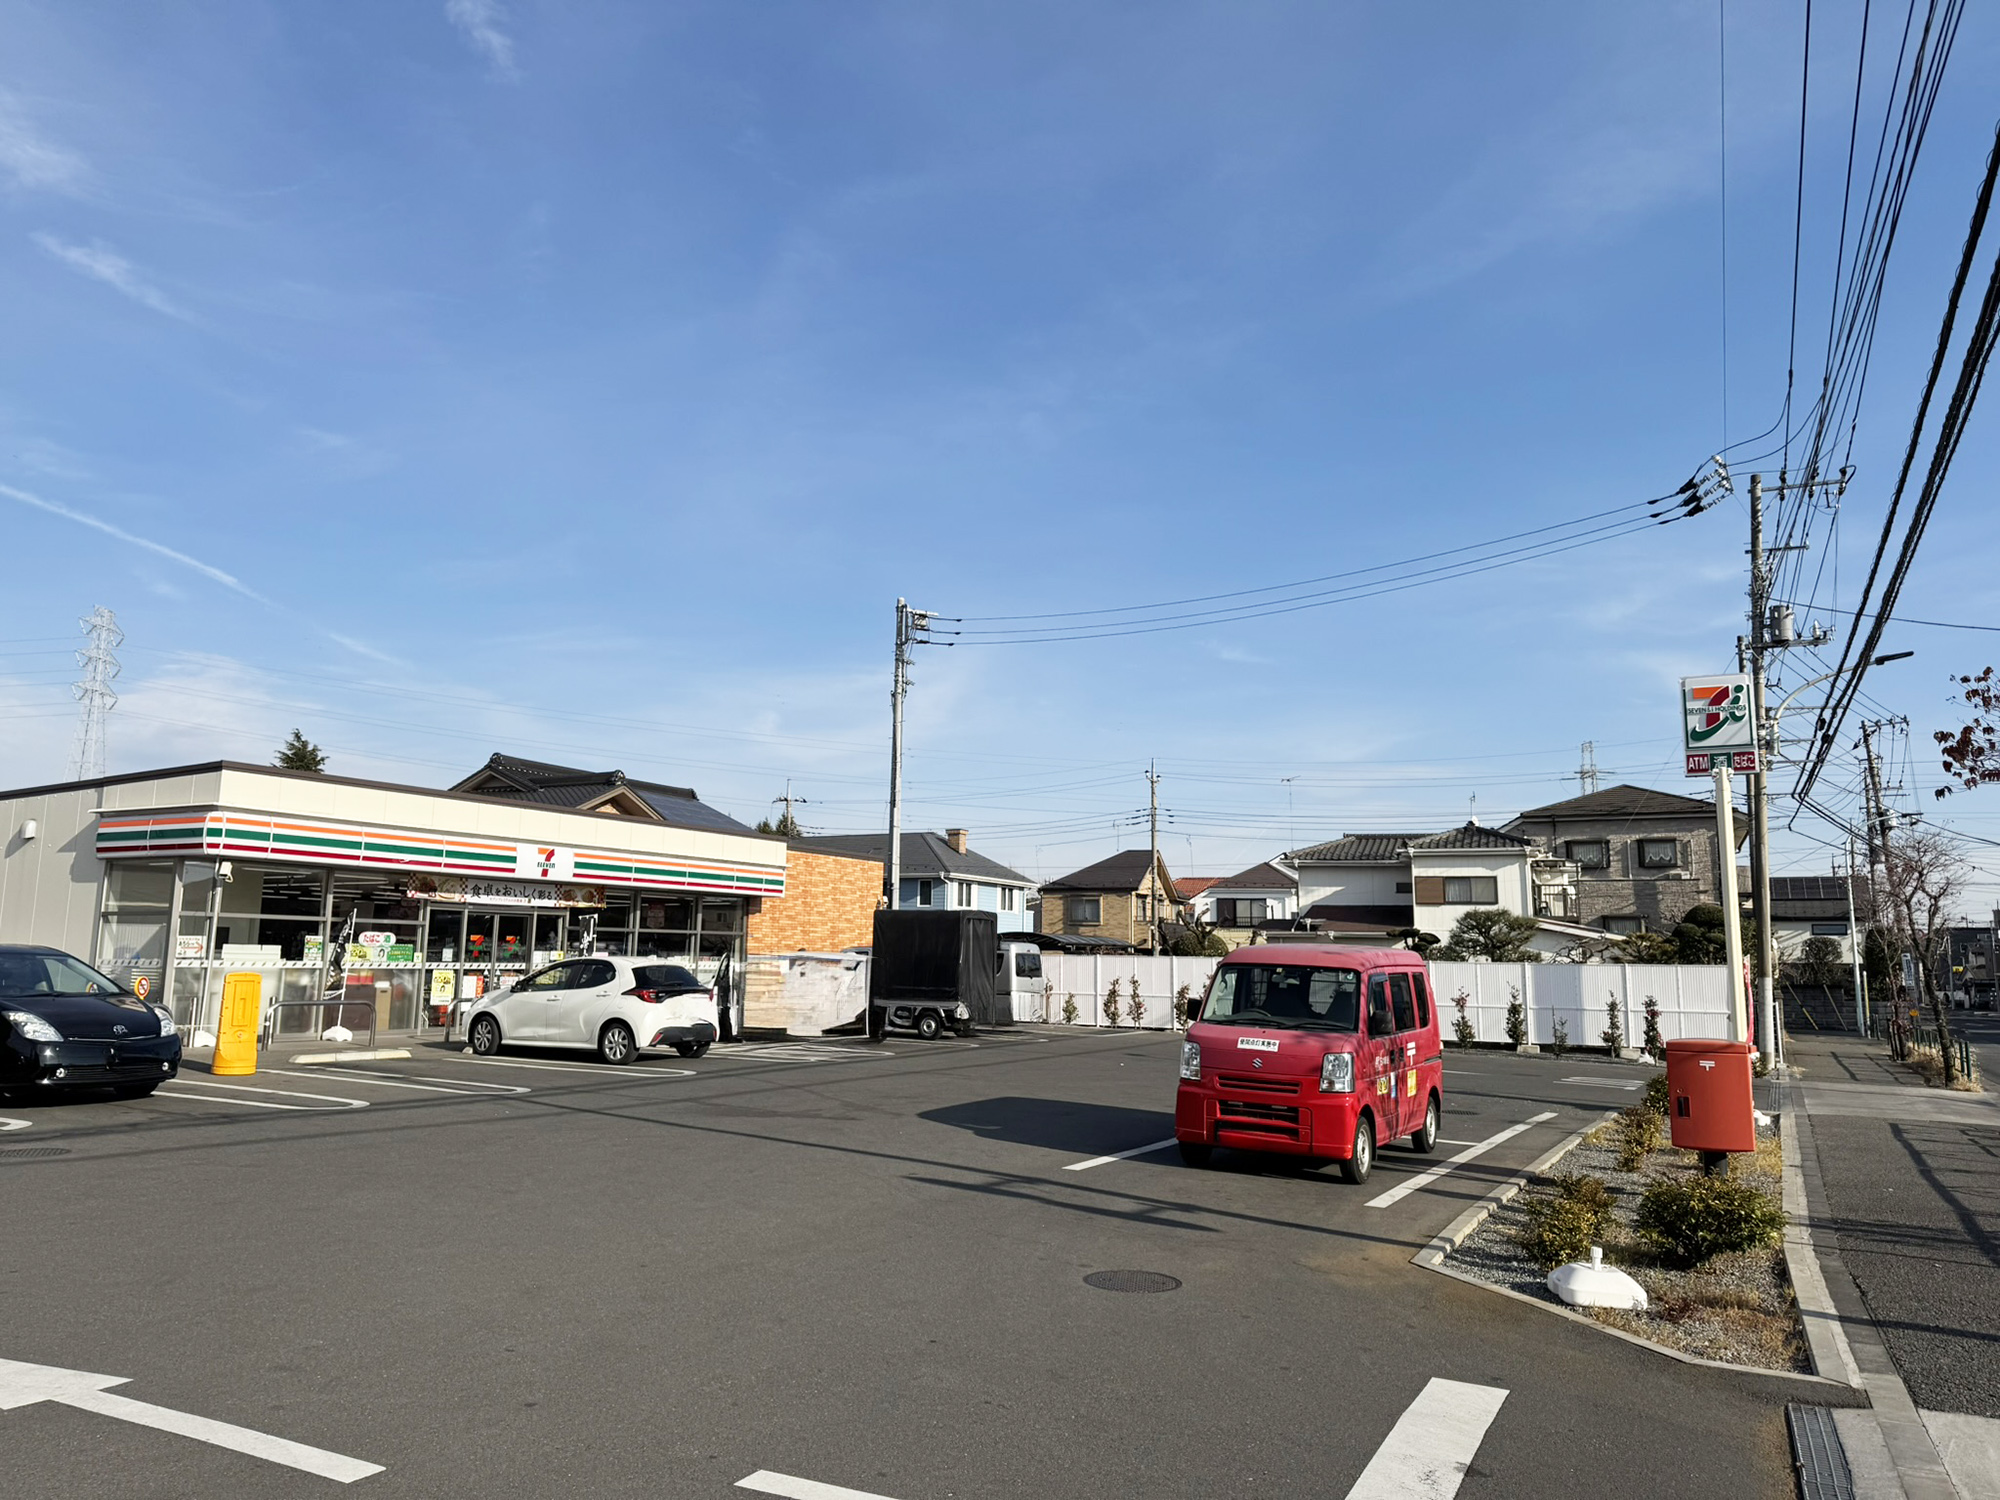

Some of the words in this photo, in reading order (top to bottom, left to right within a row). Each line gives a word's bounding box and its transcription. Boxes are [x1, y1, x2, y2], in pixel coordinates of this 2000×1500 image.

[1715, 704, 1747, 713] HOLDINGS
[1688, 756, 1709, 770] ATM
[1713, 755, 1728, 770] 酒
[1733, 754, 1755, 768] たばこ
[470, 883, 553, 900] 食卓をおいしく彩る
[363, 934, 381, 943] たばこ
